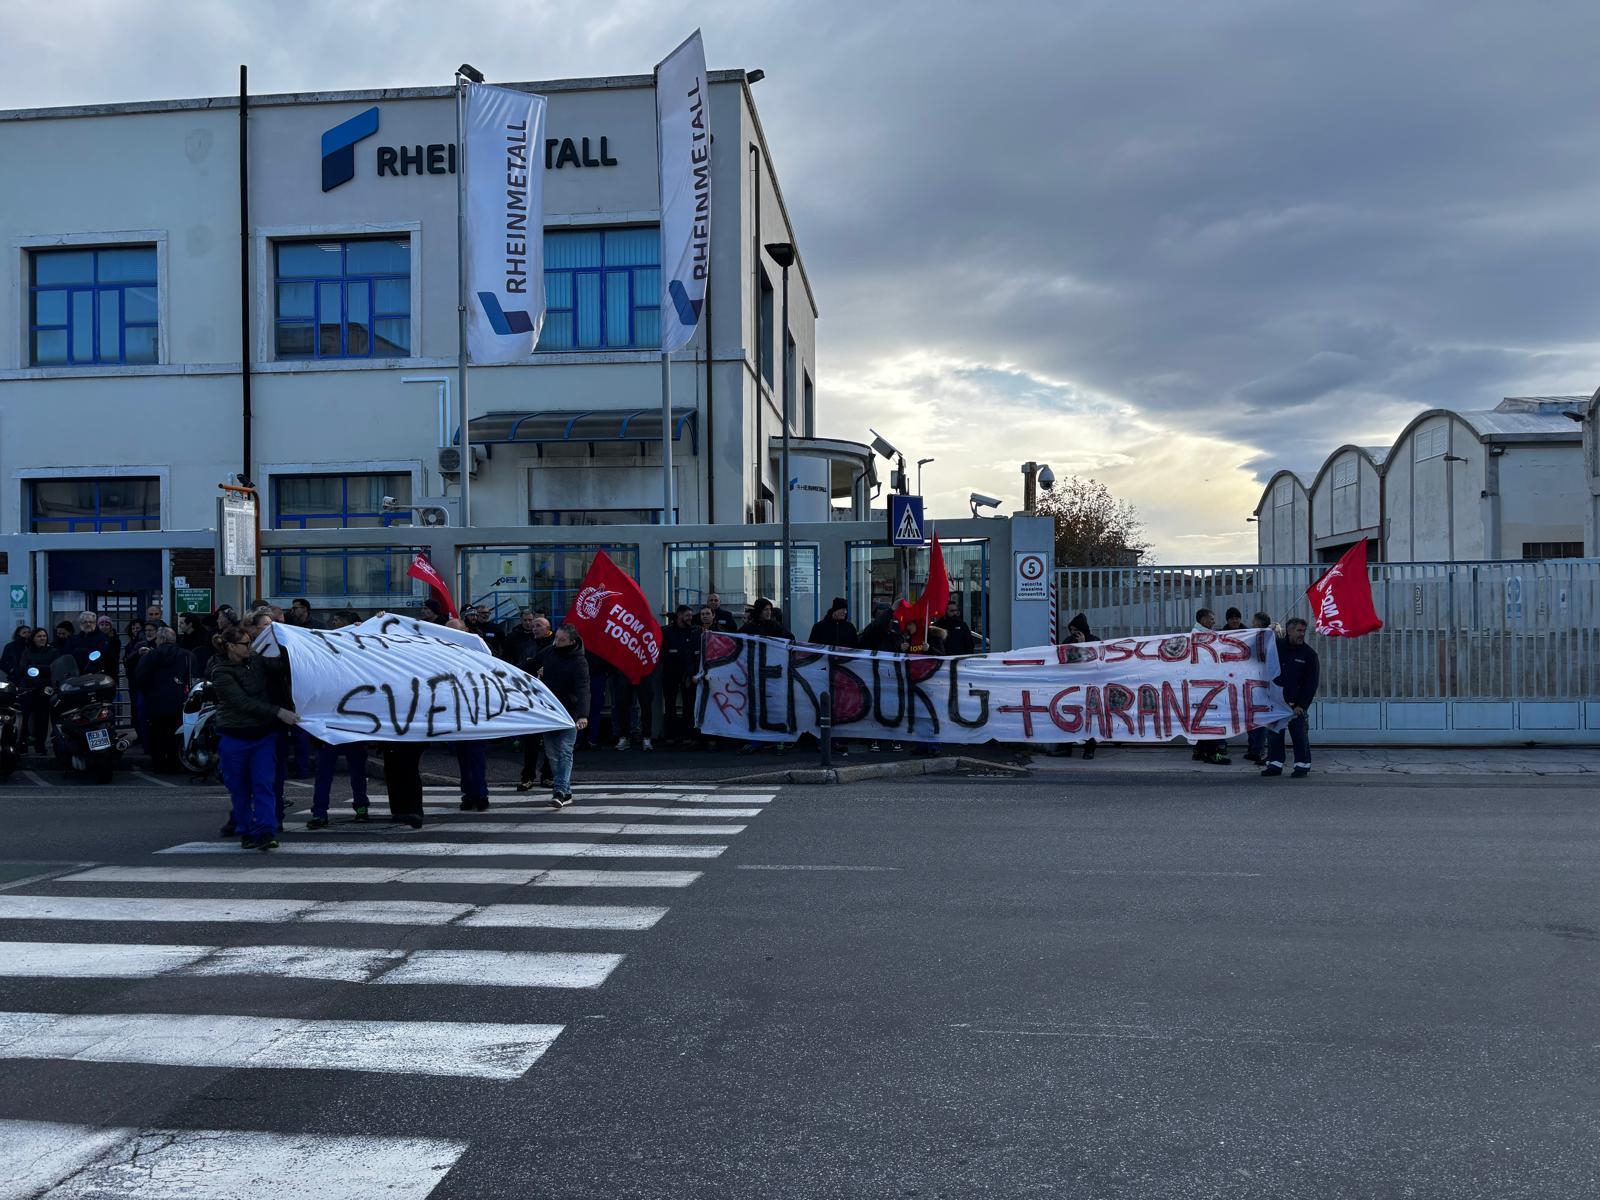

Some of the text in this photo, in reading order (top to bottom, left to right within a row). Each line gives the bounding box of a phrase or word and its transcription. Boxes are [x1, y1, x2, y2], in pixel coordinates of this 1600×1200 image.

[377, 135, 618, 177] RHEITALL
[687, 76, 708, 281] RHEINMETALL
[506, 120, 527, 294] RHEINMETALL
[1028, 562, 1036, 575] 5
[609, 603, 645, 634] FIOM
